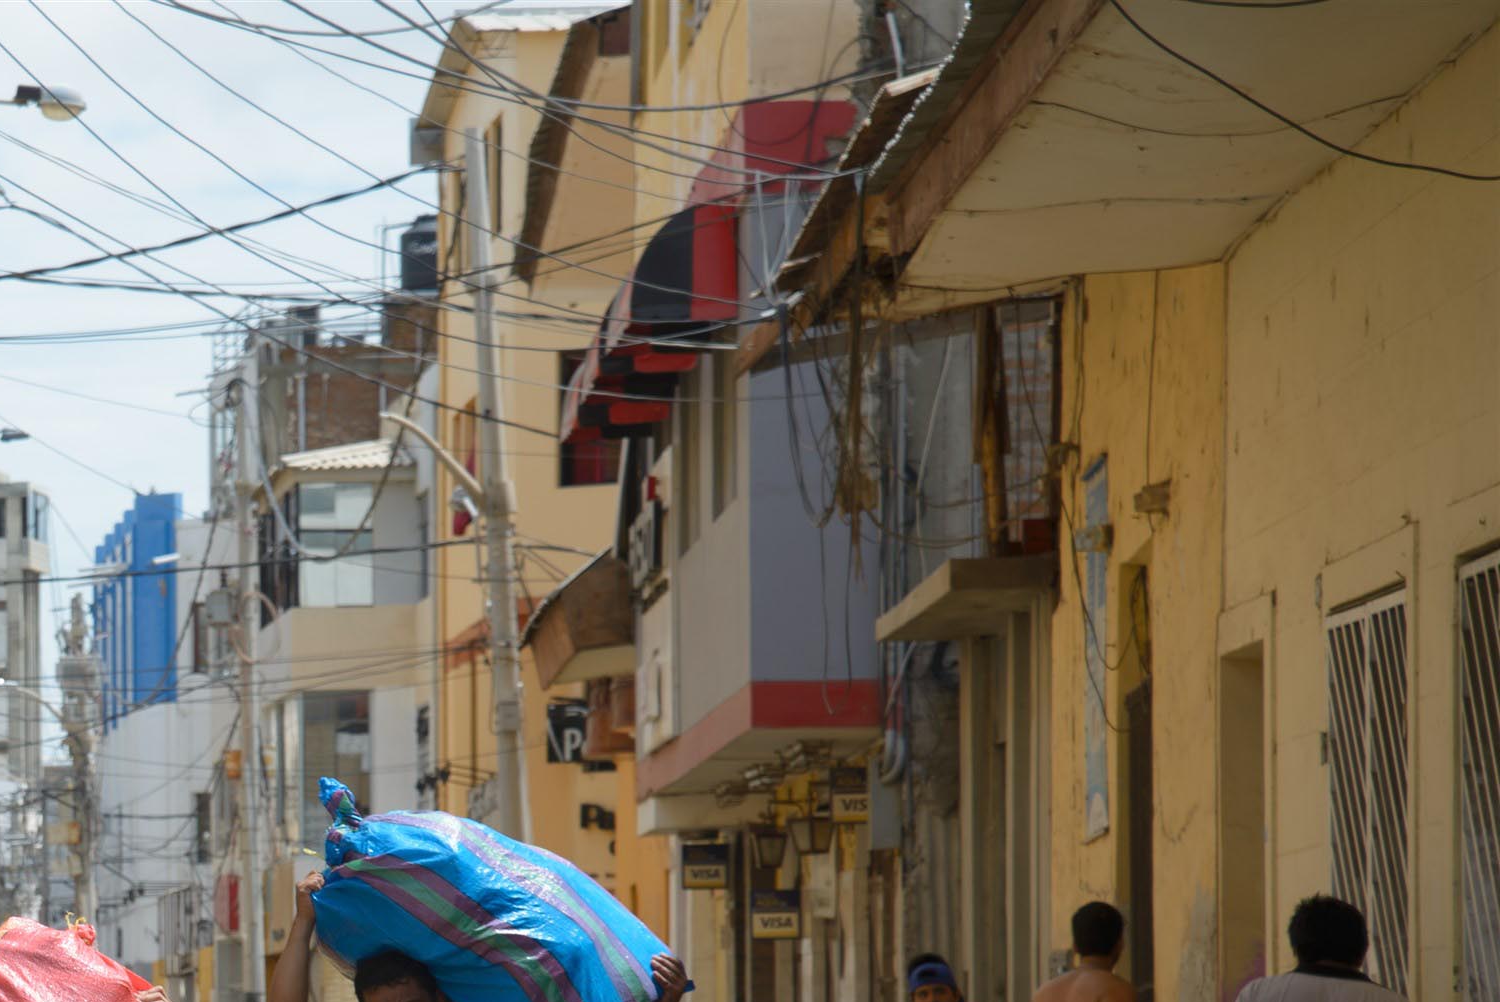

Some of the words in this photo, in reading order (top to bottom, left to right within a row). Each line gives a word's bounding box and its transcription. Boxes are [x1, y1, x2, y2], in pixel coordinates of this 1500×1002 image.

[841, 798, 868, 812] VIS
[690, 868, 721, 881] VISA
[759, 916, 793, 929] VISA
